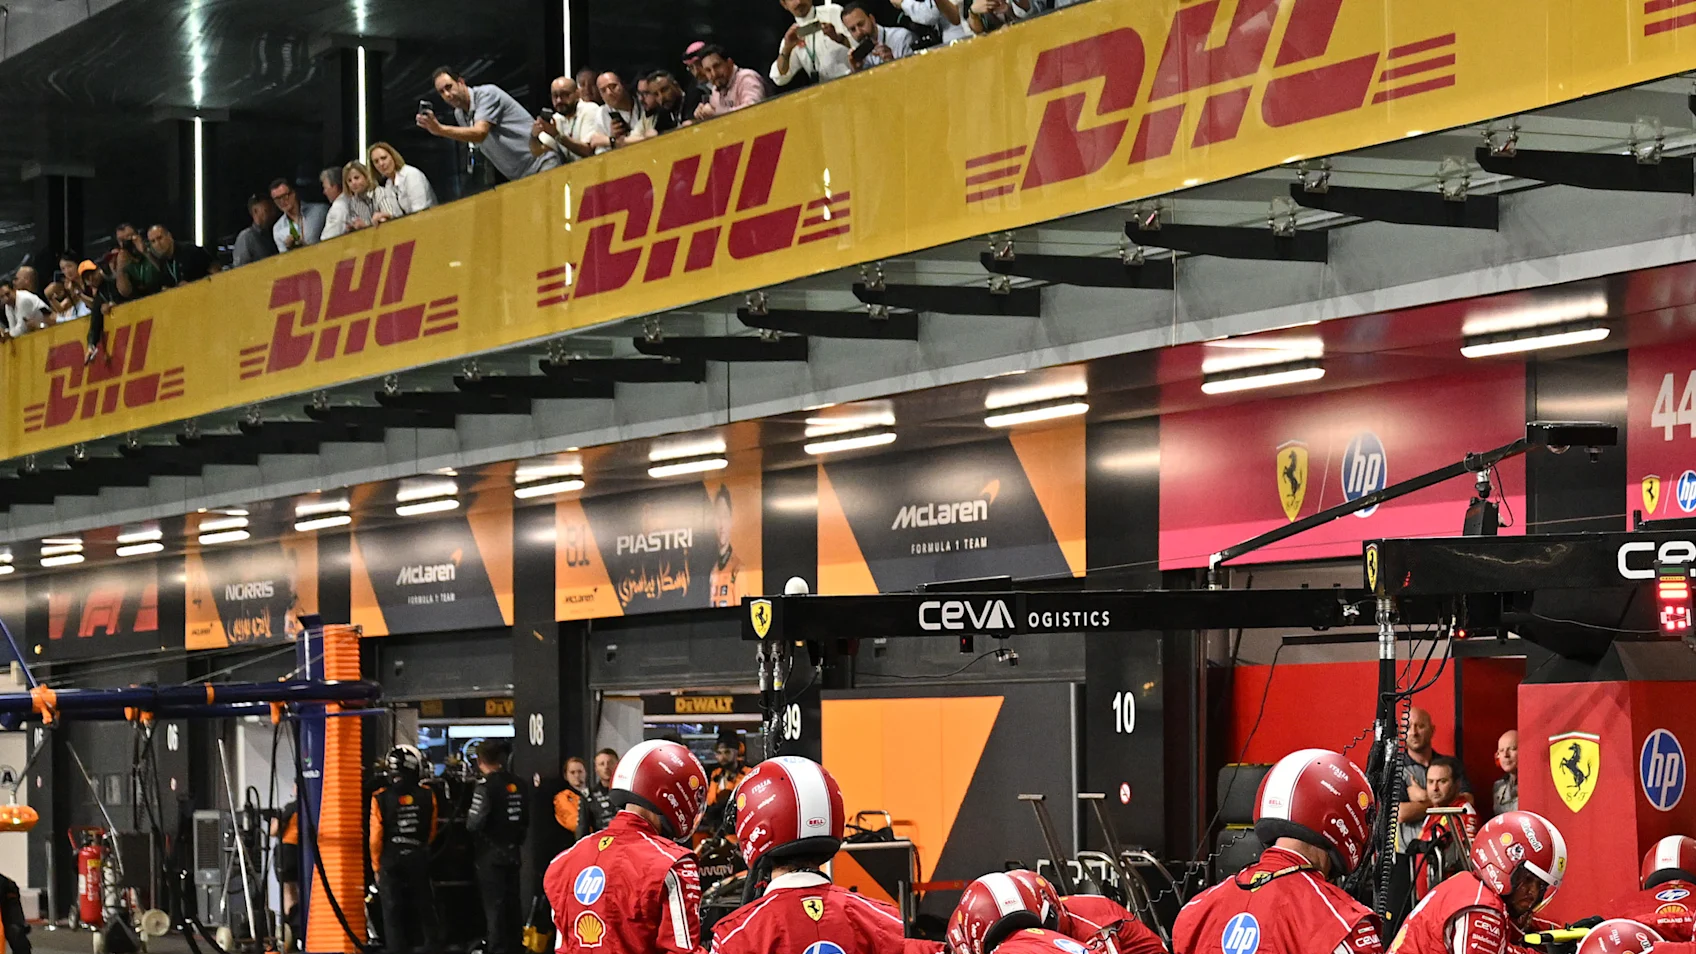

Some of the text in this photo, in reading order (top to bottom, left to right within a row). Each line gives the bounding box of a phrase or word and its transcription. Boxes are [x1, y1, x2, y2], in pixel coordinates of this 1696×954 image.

[1021, 0, 1379, 190] DHL
[573, 128, 802, 298] DHL
[266, 240, 425, 371] DHL
[44, 319, 160, 427] DHL
[1344, 433, 1386, 516] hp
[892, 500, 987, 530] McLaren
[617, 528, 693, 556] PIASTRI
[911, 540, 951, 555] FORMULA
[964, 536, 988, 550] TEAM
[225, 580, 274, 601] NORRIS
[396, 563, 455, 585] McLaren
[918, 600, 1110, 630] CEVA OGISTICS
[528, 712, 544, 746] 08
[783, 703, 801, 741] 09
[1111, 691, 1136, 735] 10
[1328, 763, 1349, 782] ITALIA
[1645, 730, 1682, 810] hp
[1522, 820, 1544, 853] UniCredit
[576, 866, 603, 905] hp
[1486, 863, 1505, 895] CEVA
[1474, 920, 1501, 936] CEVA
